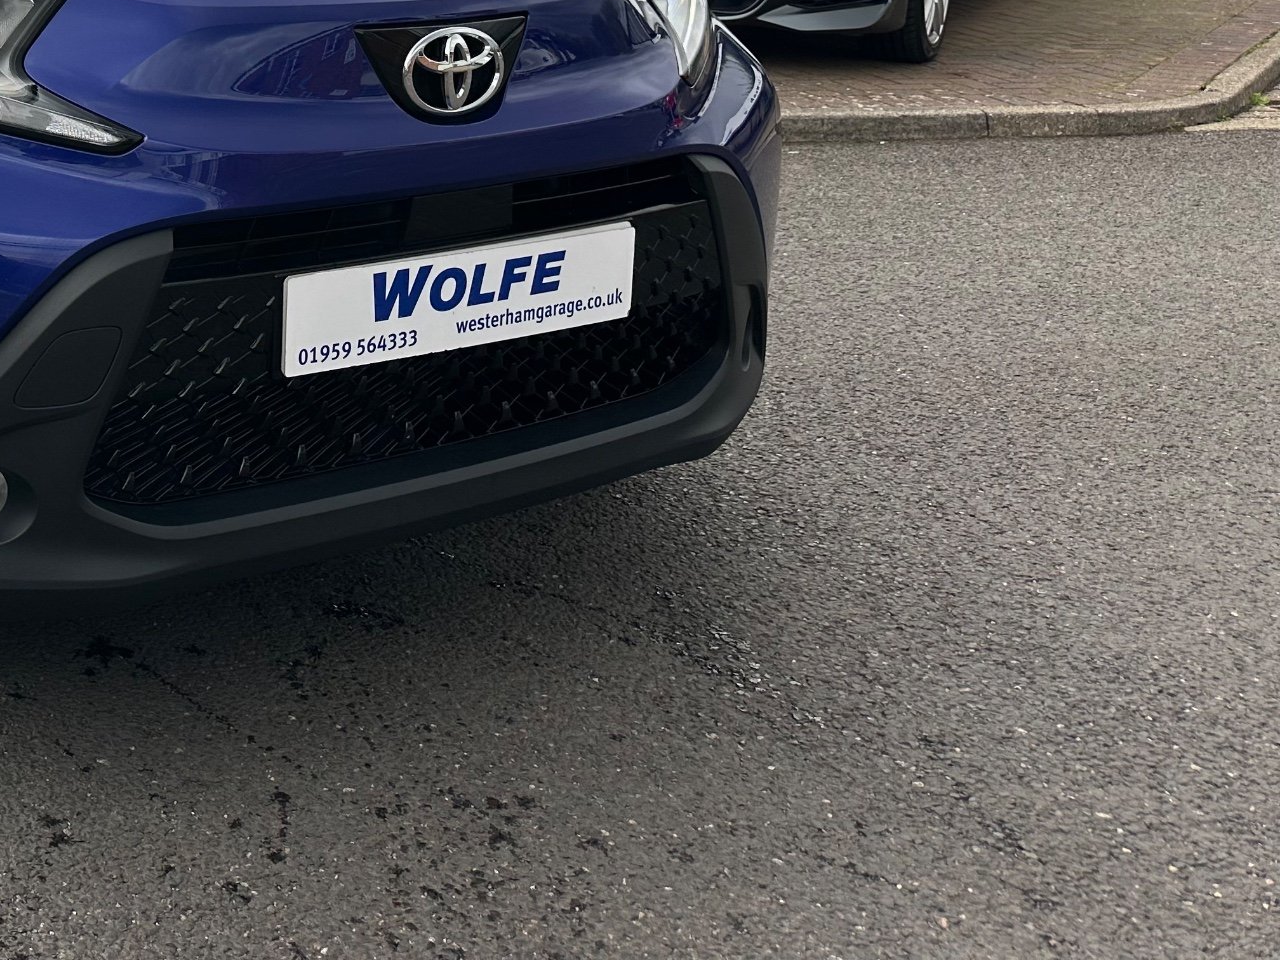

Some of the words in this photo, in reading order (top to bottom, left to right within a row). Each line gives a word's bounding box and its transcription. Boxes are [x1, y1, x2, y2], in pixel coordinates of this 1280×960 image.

[372, 250, 566, 323] WOLFE
[455, 288, 623, 334] westerhamgarage.co.uk
[298, 341, 352, 366] 01959
[356, 329, 418, 357] 564333
